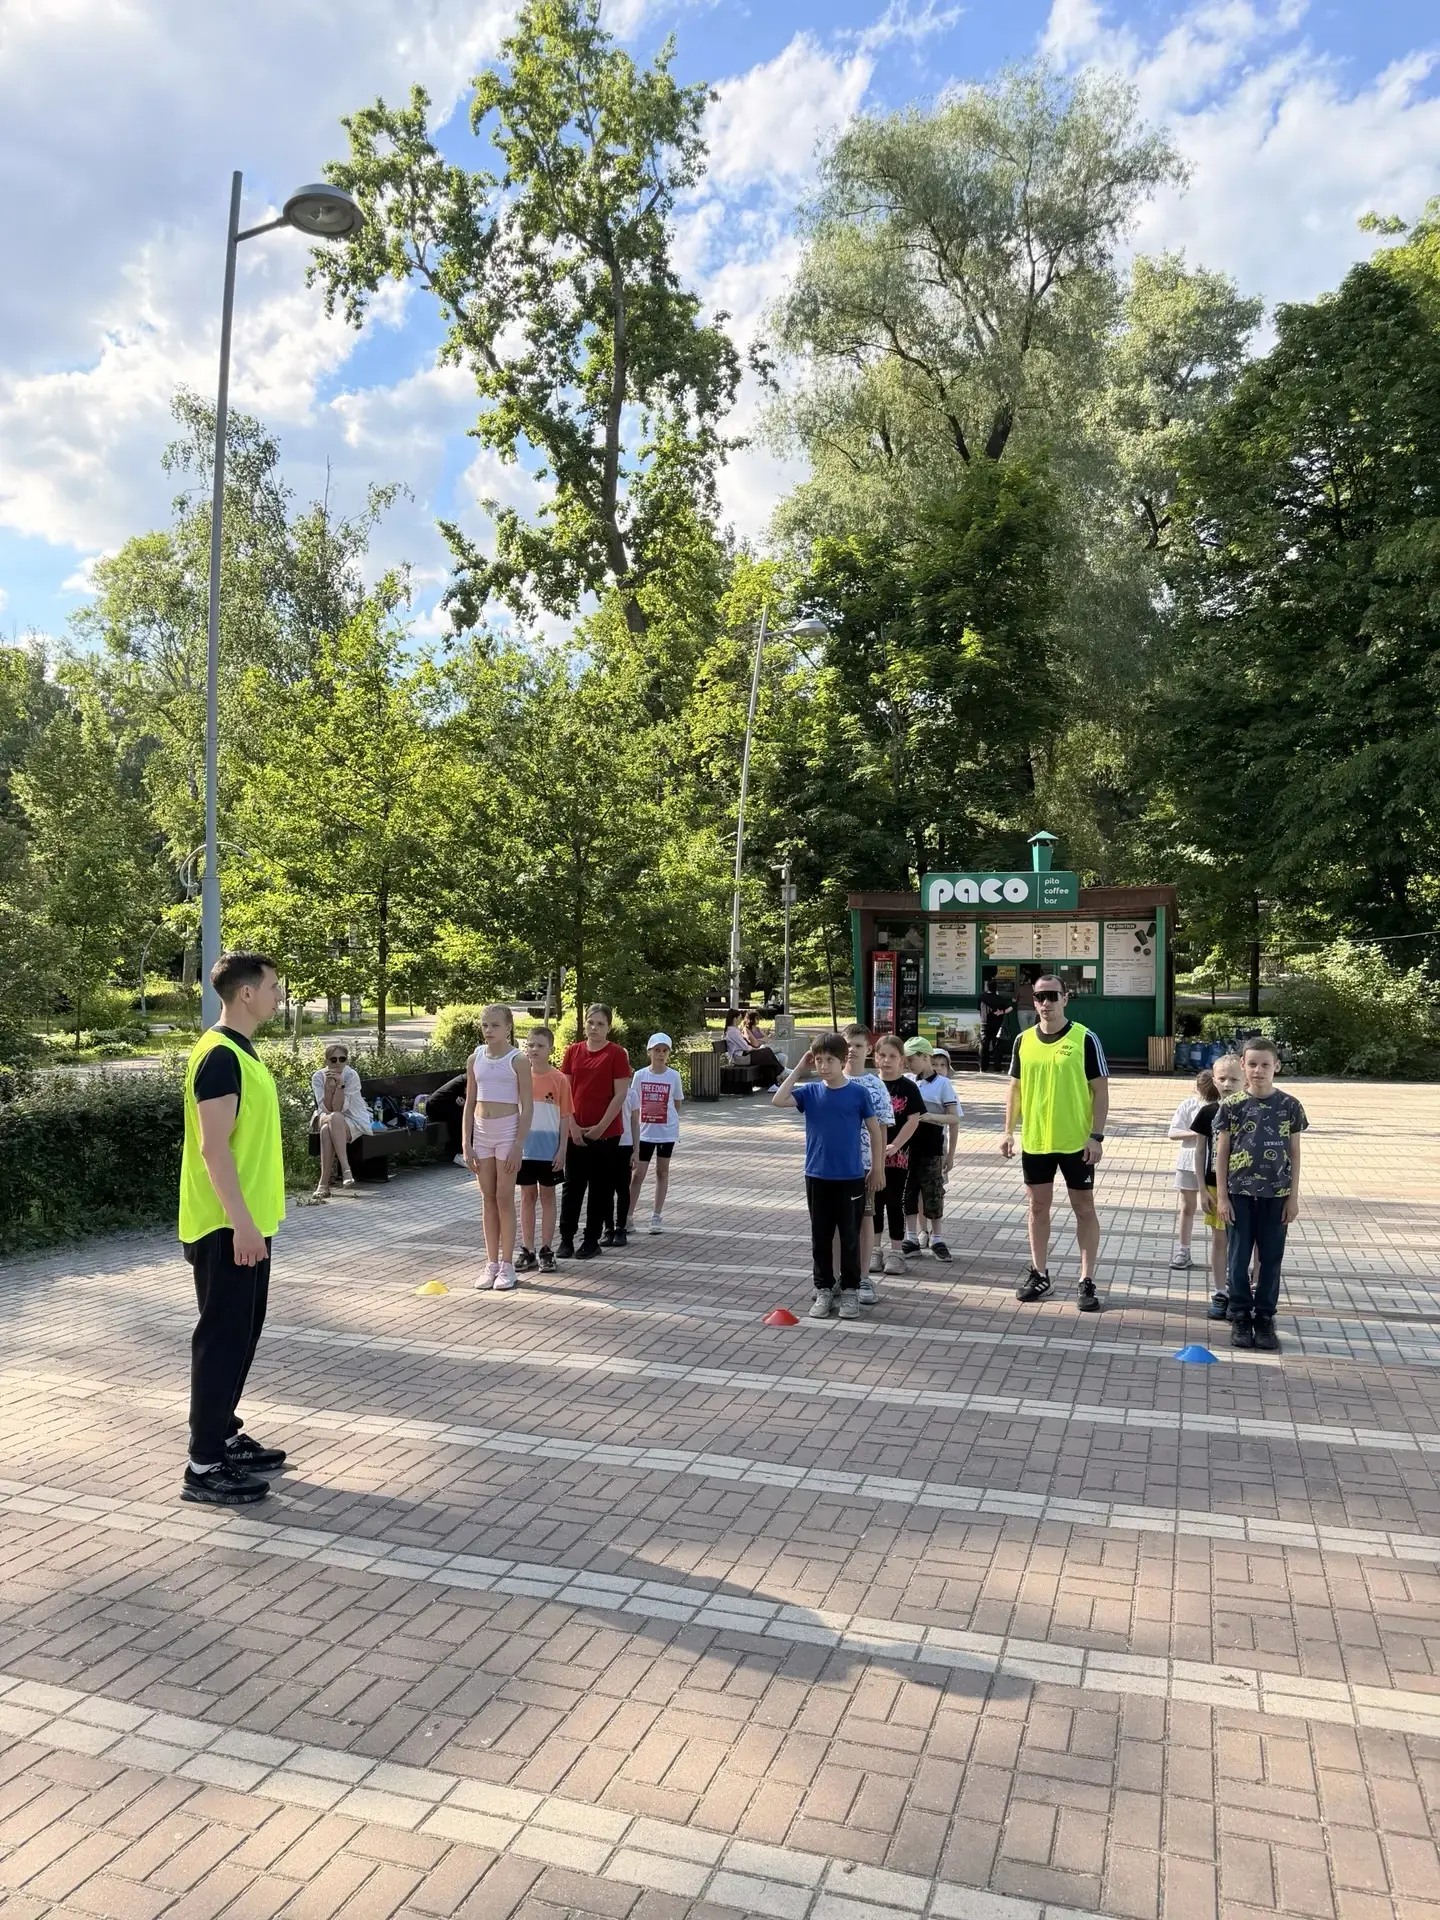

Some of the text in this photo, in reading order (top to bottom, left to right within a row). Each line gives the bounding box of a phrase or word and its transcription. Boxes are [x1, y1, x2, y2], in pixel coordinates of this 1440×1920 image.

[1044, 877, 1060, 886] pita
[928, 878, 1029, 911] paco
[1044, 887, 1069, 895] coffee
[1044, 897, 1058, 905] bar
[642, 1083, 669, 1093] FREEDOM
